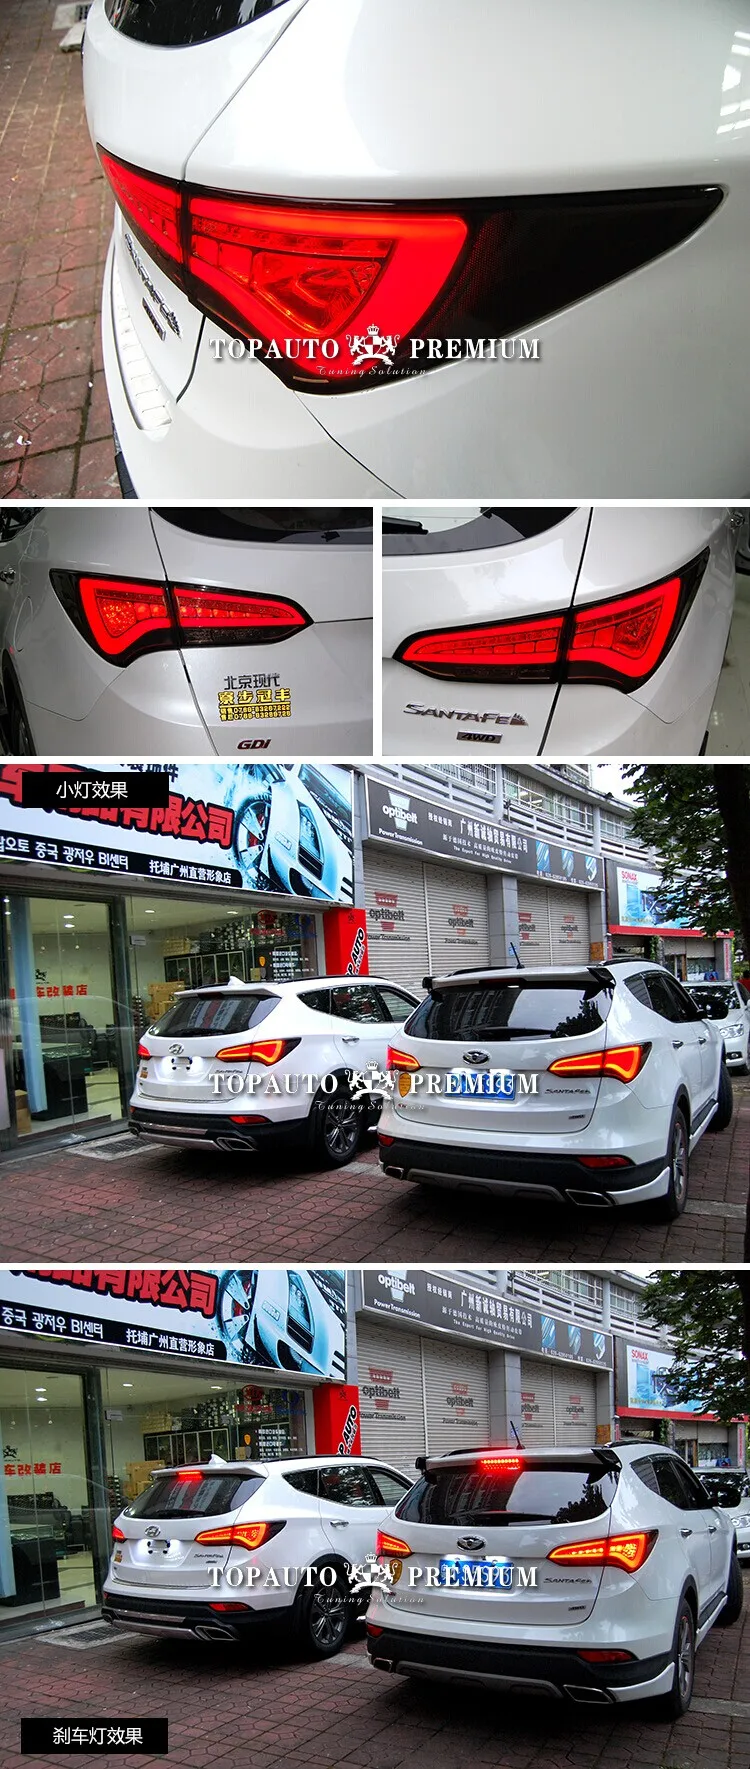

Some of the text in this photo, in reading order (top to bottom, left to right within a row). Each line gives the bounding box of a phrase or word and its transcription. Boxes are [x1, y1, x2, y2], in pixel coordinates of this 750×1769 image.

[224, 673, 280, 690] 北京现代
[237, 739, 271, 749] GDI
[461, 732, 496, 742] 4WD
[382, 805, 418, 824] optibelt
[35, 841, 59, 860] 중국
[63, 846, 95, 864] 광저우
[621, 871, 638, 881] SONAX
[350, 927, 365, 969] AUTO
[378, 1274, 416, 1295] optibelt
[1, 1306, 27, 1327] 중국
[32, 1311, 67, 1332] 광저우
[631, 1349, 649, 1361] SONAX
[342, 1404, 357, 1445] AUTO
